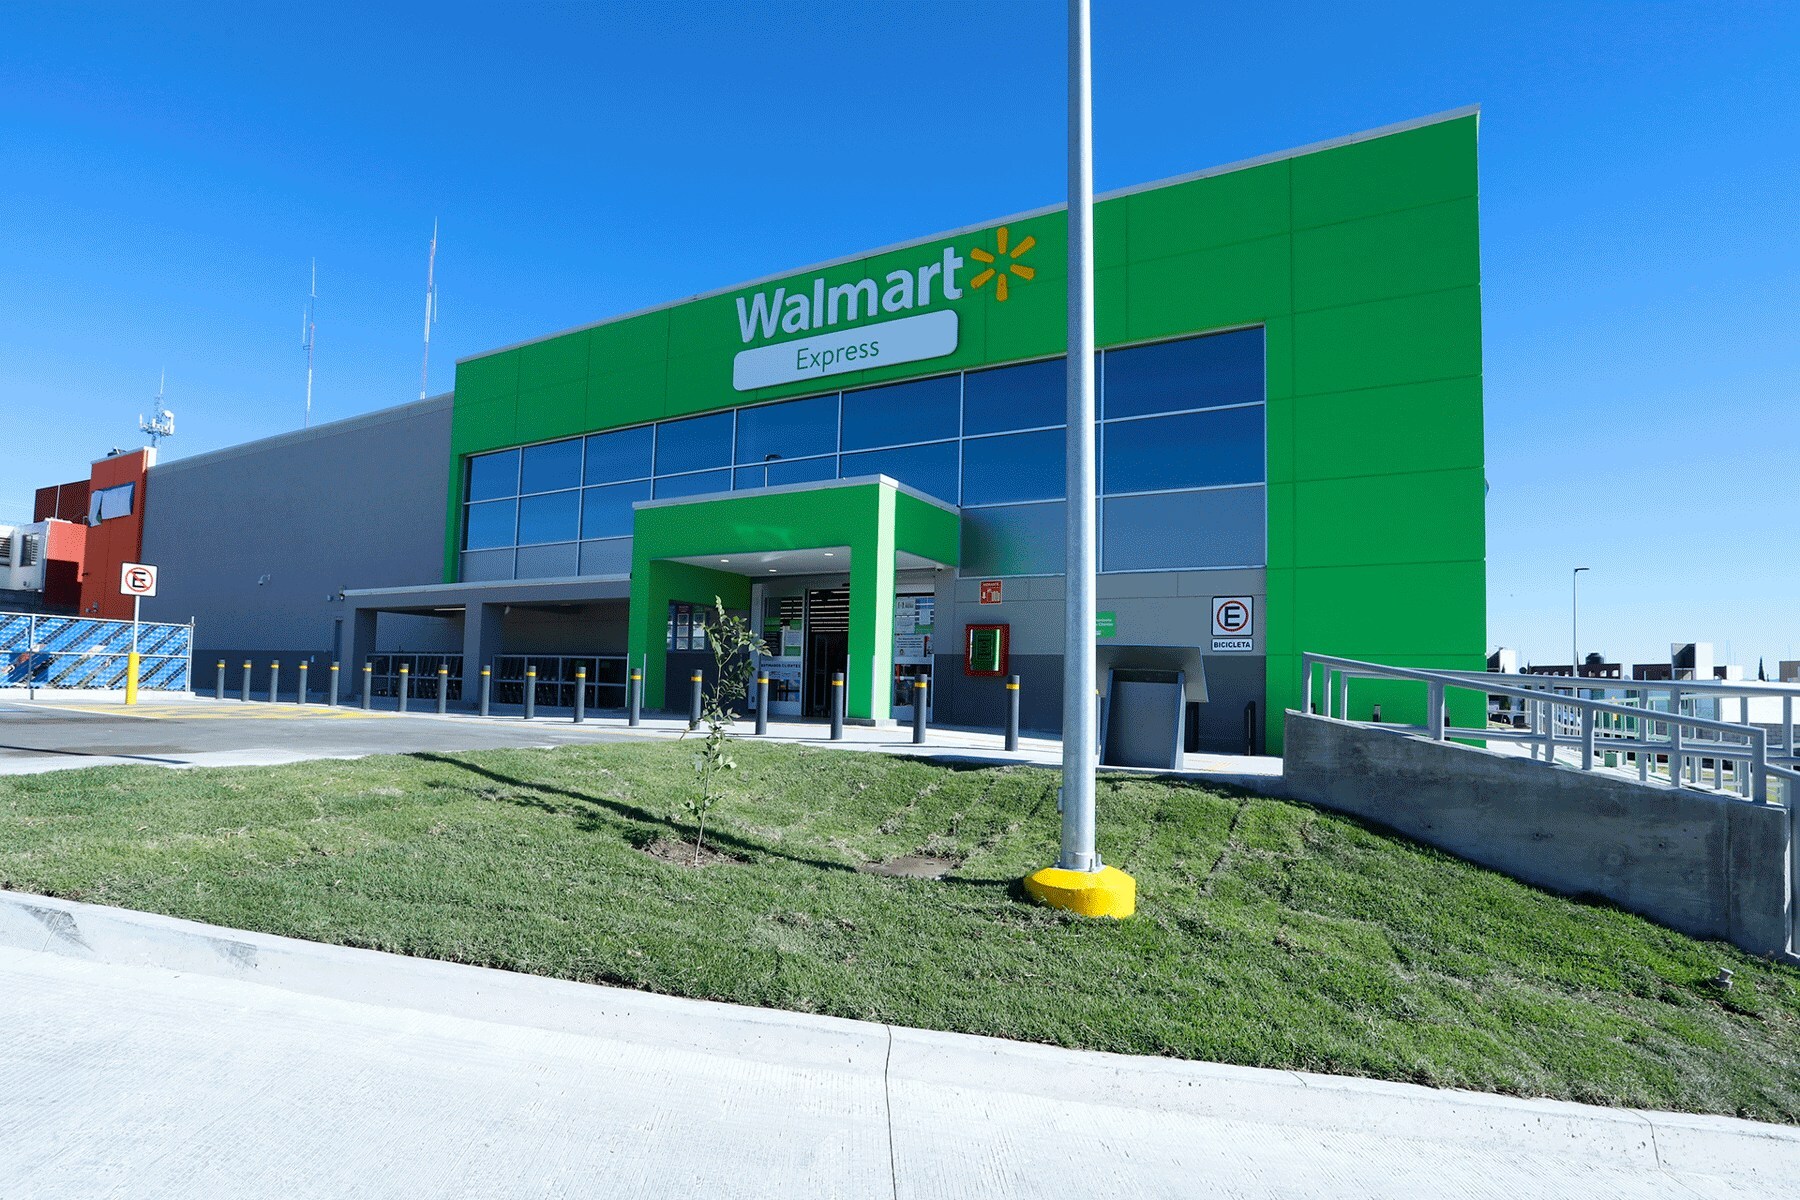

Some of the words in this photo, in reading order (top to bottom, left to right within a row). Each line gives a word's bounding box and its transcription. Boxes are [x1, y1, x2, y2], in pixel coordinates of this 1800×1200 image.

[736, 247, 963, 343] Walmart
[797, 341, 879, 372] Express
[132, 571, 146, 588] E
[1225, 606, 1240, 626] E
